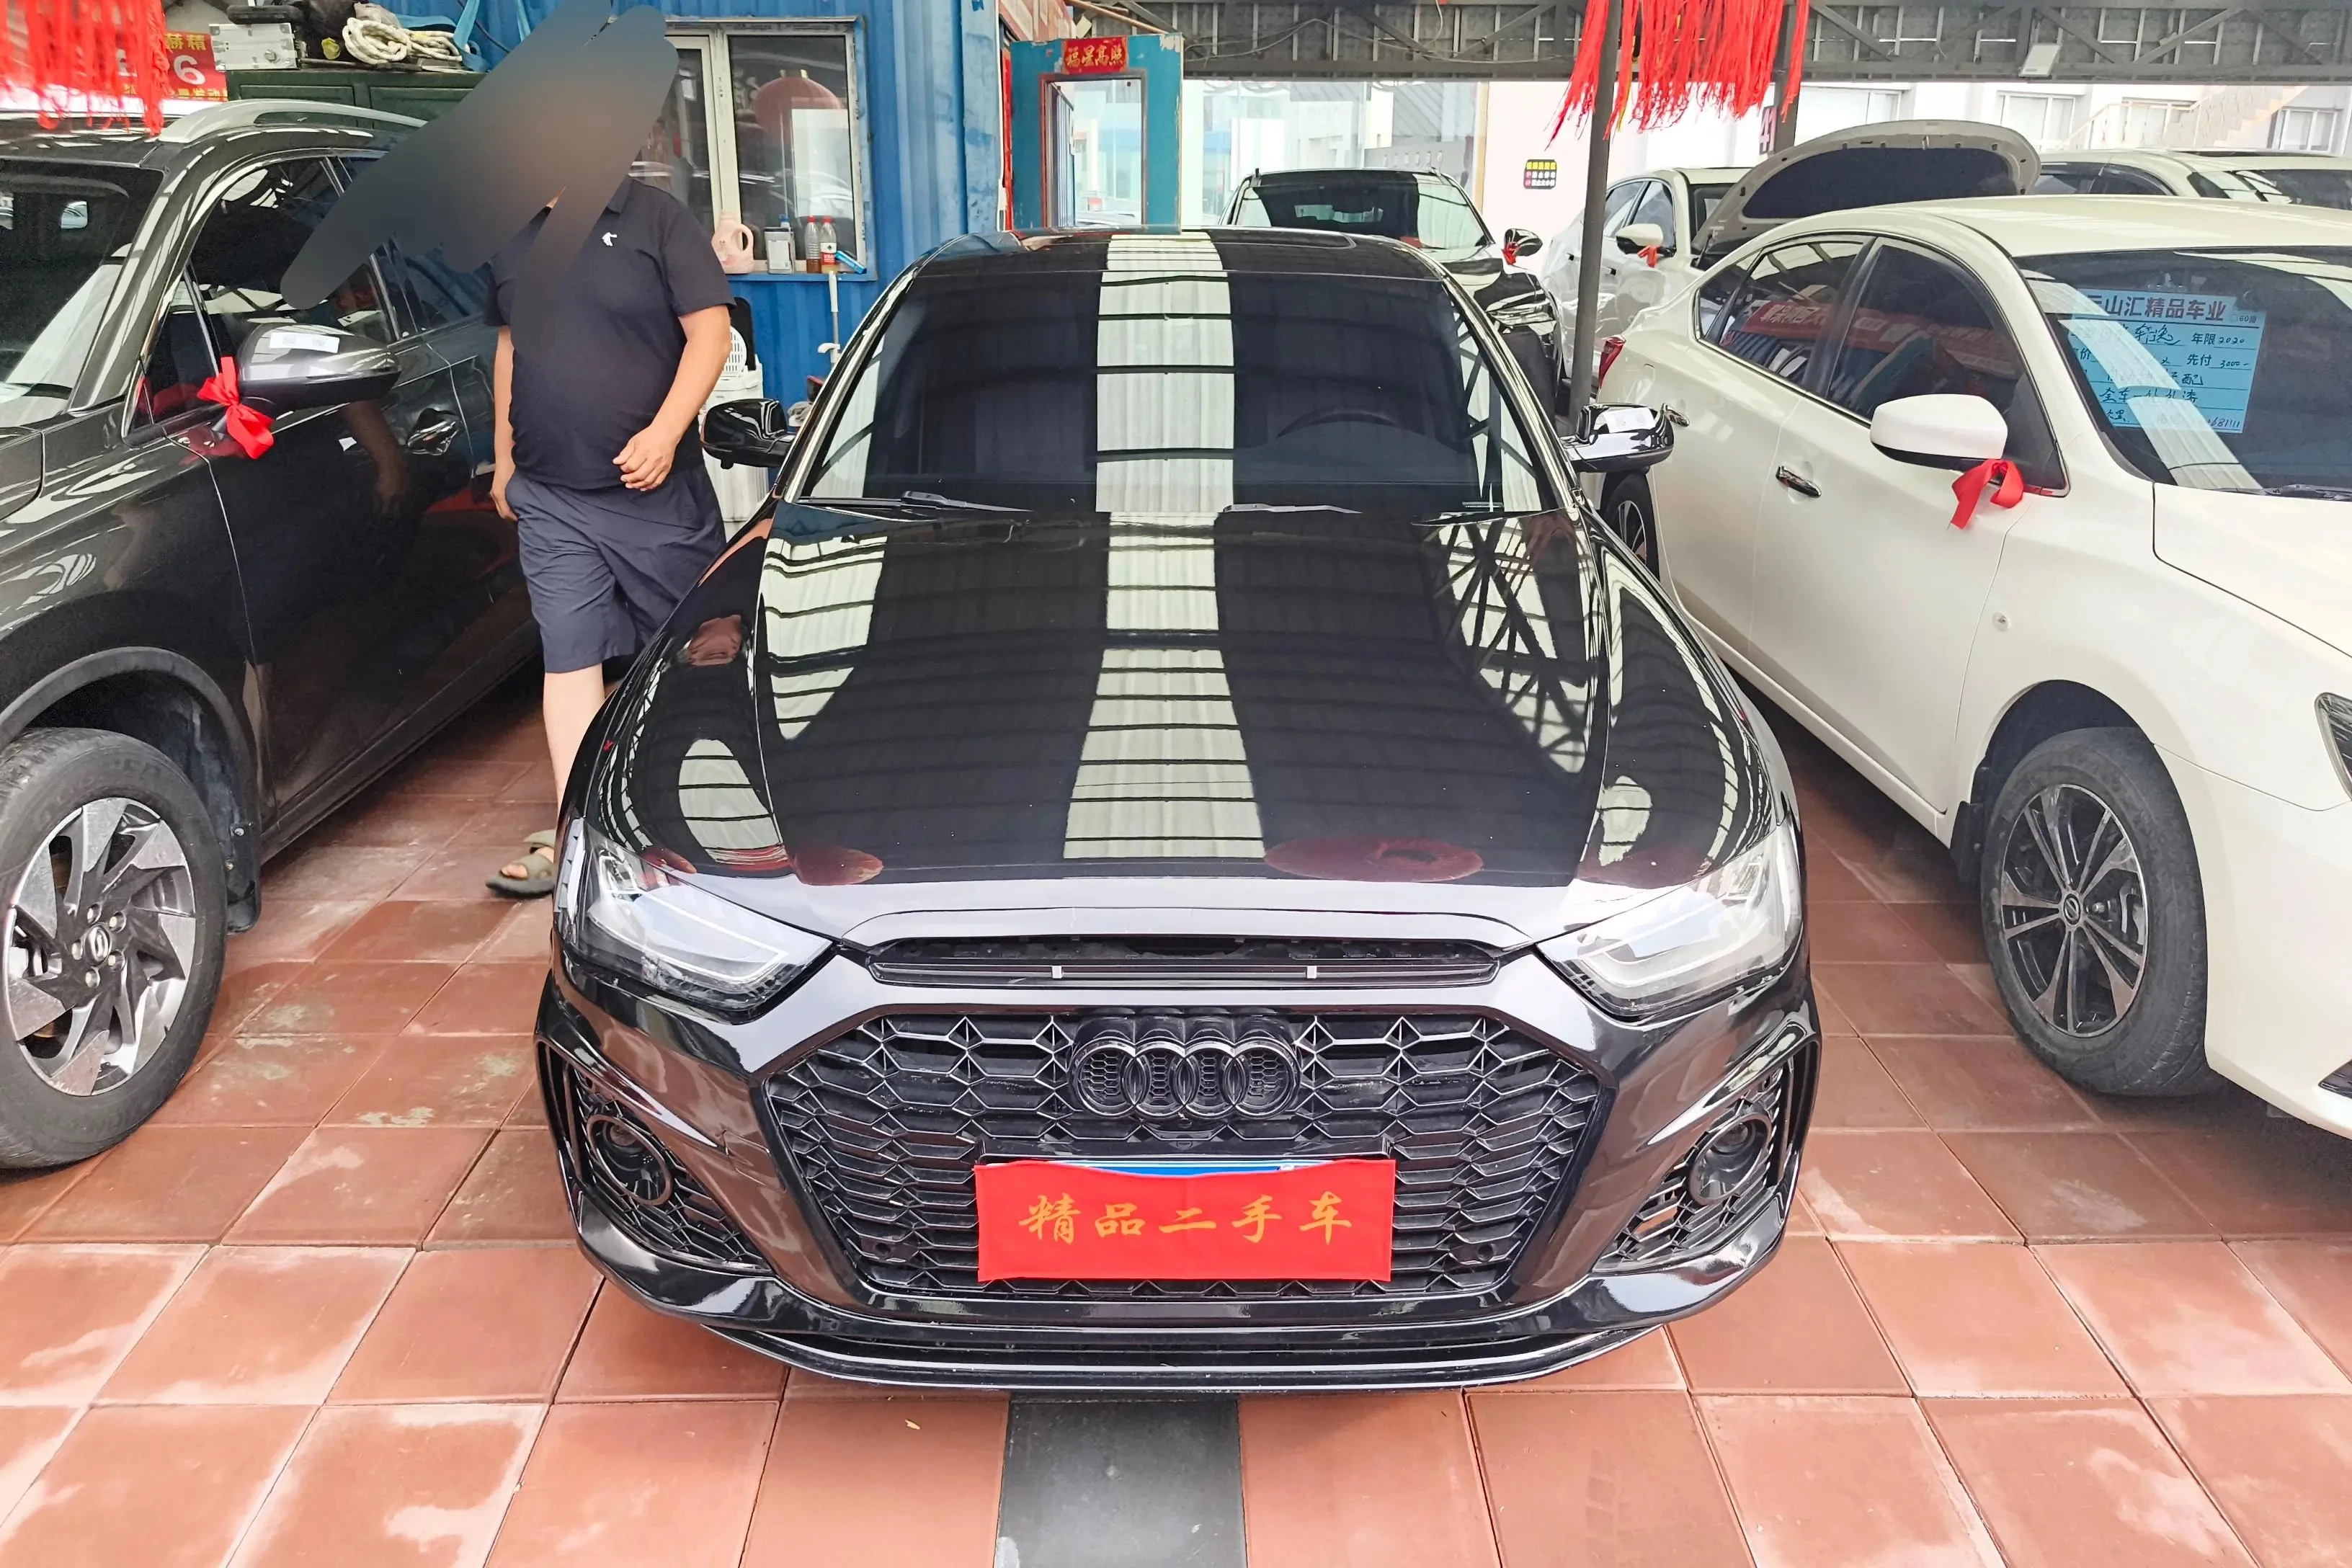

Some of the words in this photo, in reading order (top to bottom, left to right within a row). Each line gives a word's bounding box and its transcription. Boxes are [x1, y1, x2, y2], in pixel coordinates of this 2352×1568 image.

[173, 54, 206, 85] 6
[1759, 107, 1778, 151] 41
[2191, 332, 2217, 345] 年限
[2187, 353, 2212, 367] 先付
[1018, 1190, 1354, 1246] 精品二手车
